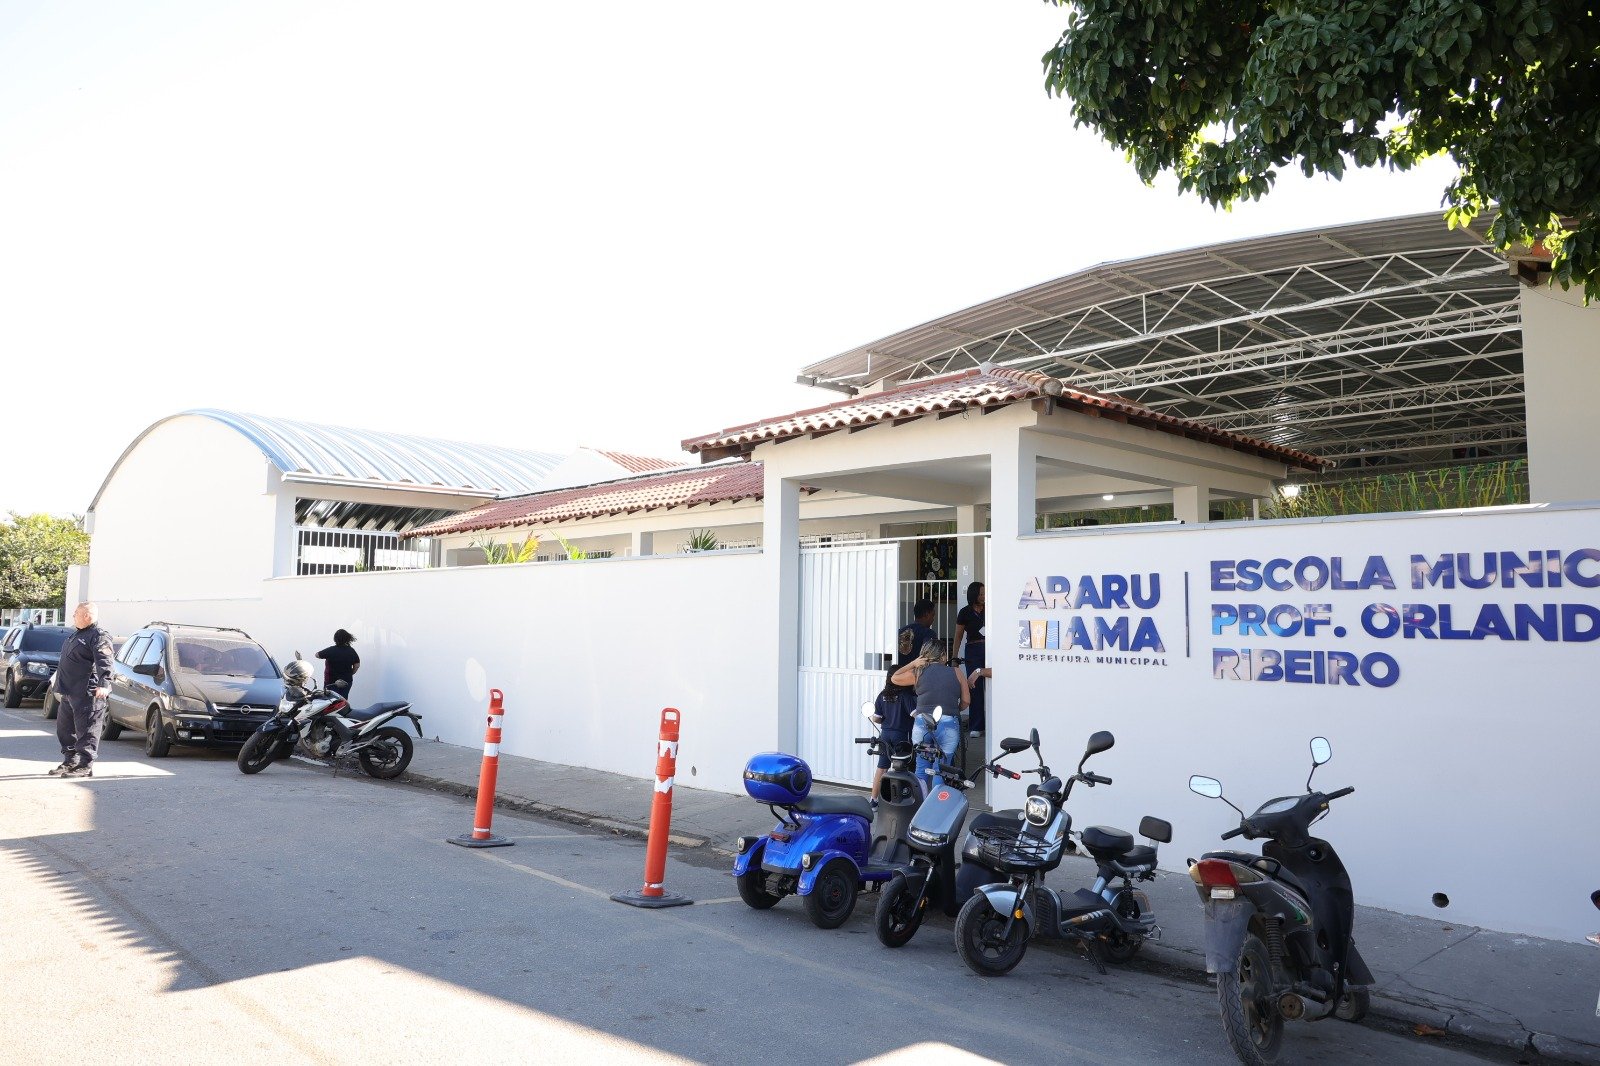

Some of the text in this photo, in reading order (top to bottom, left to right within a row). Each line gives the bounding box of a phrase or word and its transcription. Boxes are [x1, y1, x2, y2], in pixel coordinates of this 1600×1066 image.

[1210, 548, 1600, 592] ESCOLA MUNIC
[1018, 573, 1161, 610] ARARU
[1211, 602, 1600, 642] PROF. ORLAND
[1018, 653, 1168, 667] PREFEITURA MUNICIPAL
[1212, 647, 1401, 688] RIBEIRO
